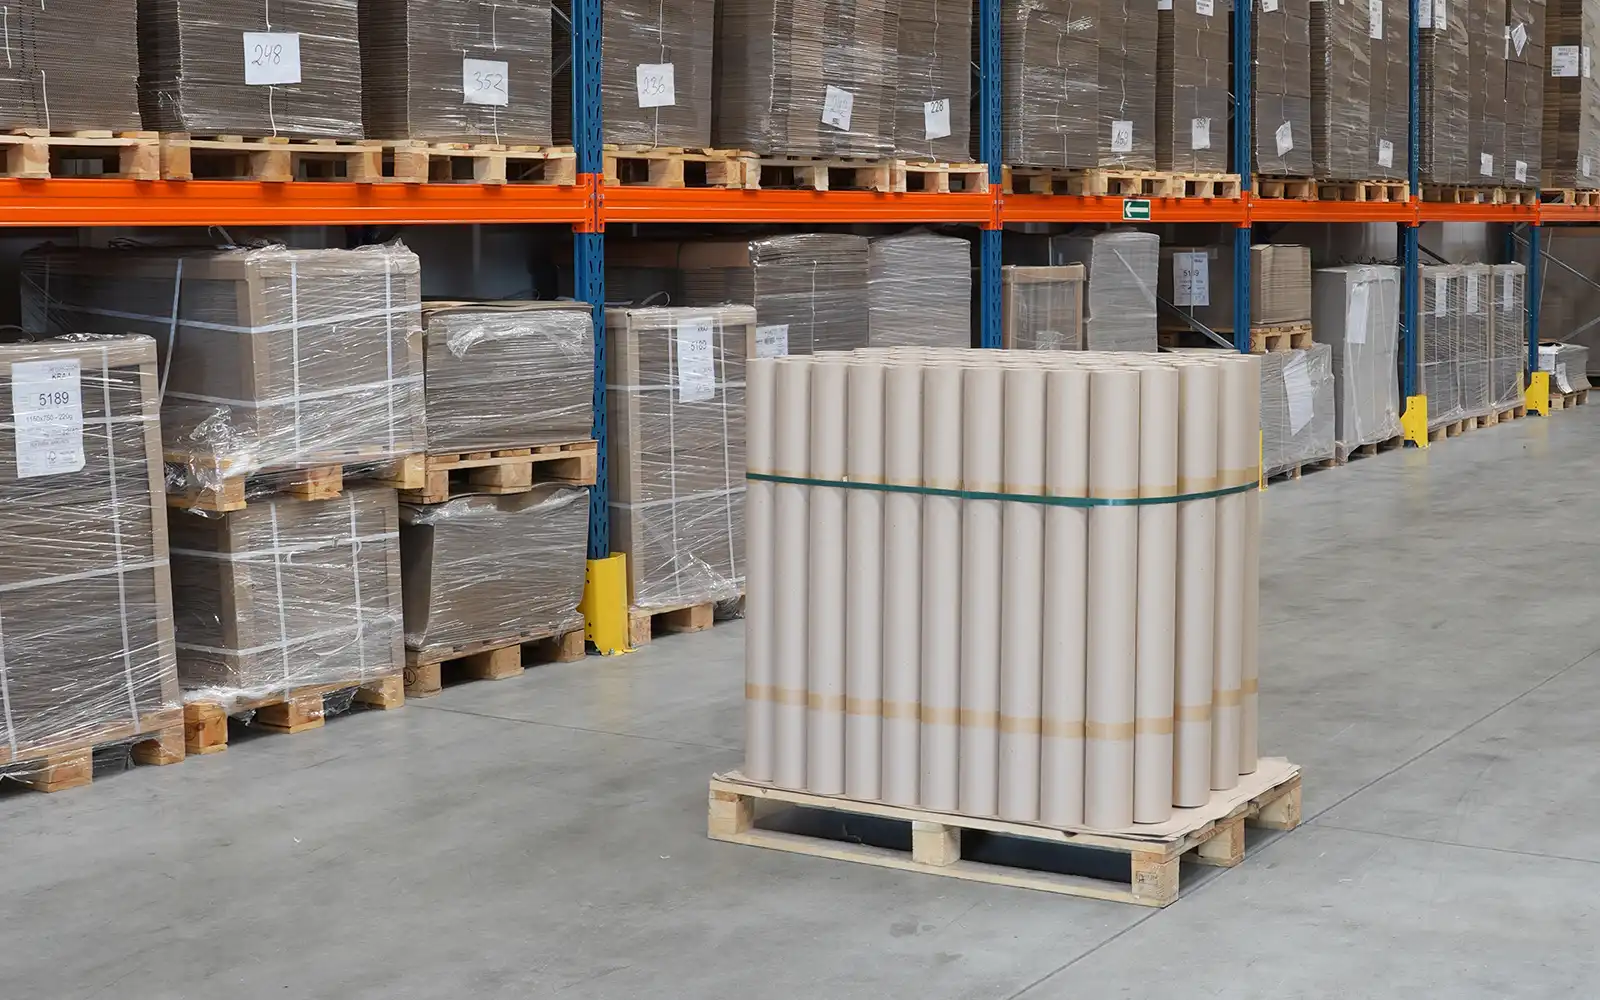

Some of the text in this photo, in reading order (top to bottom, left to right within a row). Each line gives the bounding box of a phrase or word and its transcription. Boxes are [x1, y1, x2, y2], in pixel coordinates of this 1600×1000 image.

[251, 43, 283, 66] 248
[473, 71, 507, 94] 352
[930, 99, 944, 113] 228
[1183, 269, 1200, 277] 519
[39, 391, 69, 406] 5189
